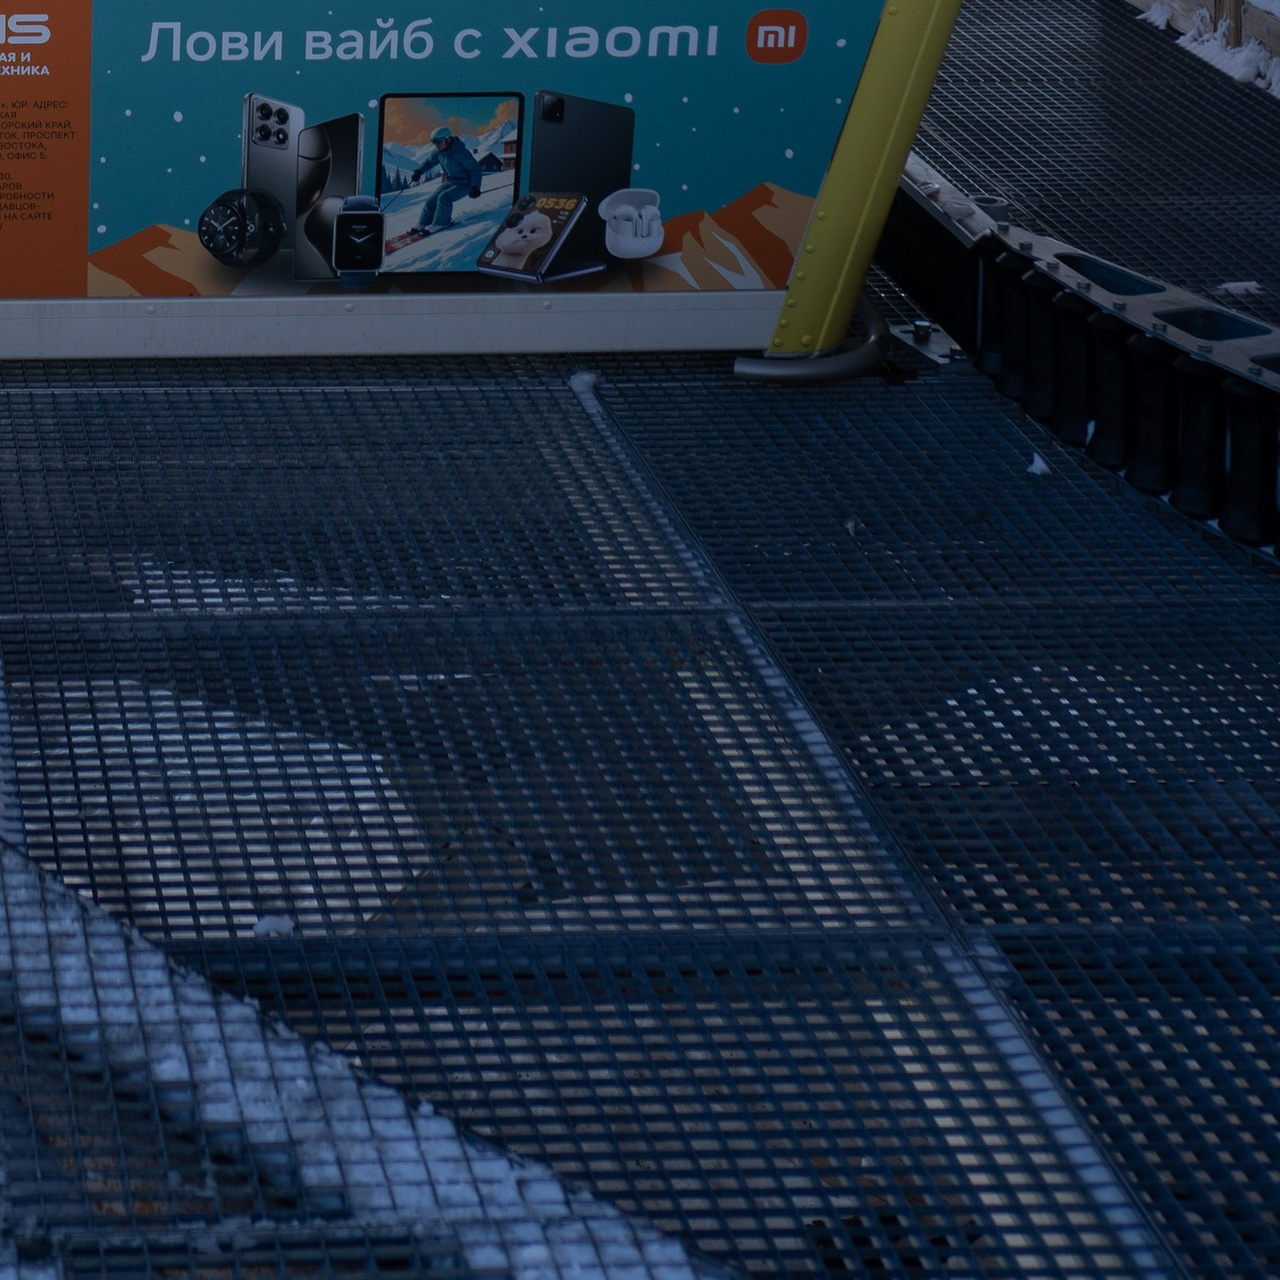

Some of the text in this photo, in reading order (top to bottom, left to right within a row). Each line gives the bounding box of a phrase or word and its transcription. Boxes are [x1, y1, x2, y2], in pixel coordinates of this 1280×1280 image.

[141, 17, 718, 63] Лови вайб с xiaomi
[21, 51, 31, 62] И
[12, 101, 29, 109] ЮР.
[33, 101, 69, 109] АДРЕС:
[45, 120, 74, 129] КРАЙ,
[23, 131, 76, 139] ПРОСПЕКТ
[7, 152, 36, 160] ОФИС
[20, 212, 53, 221] САЙТЕ
